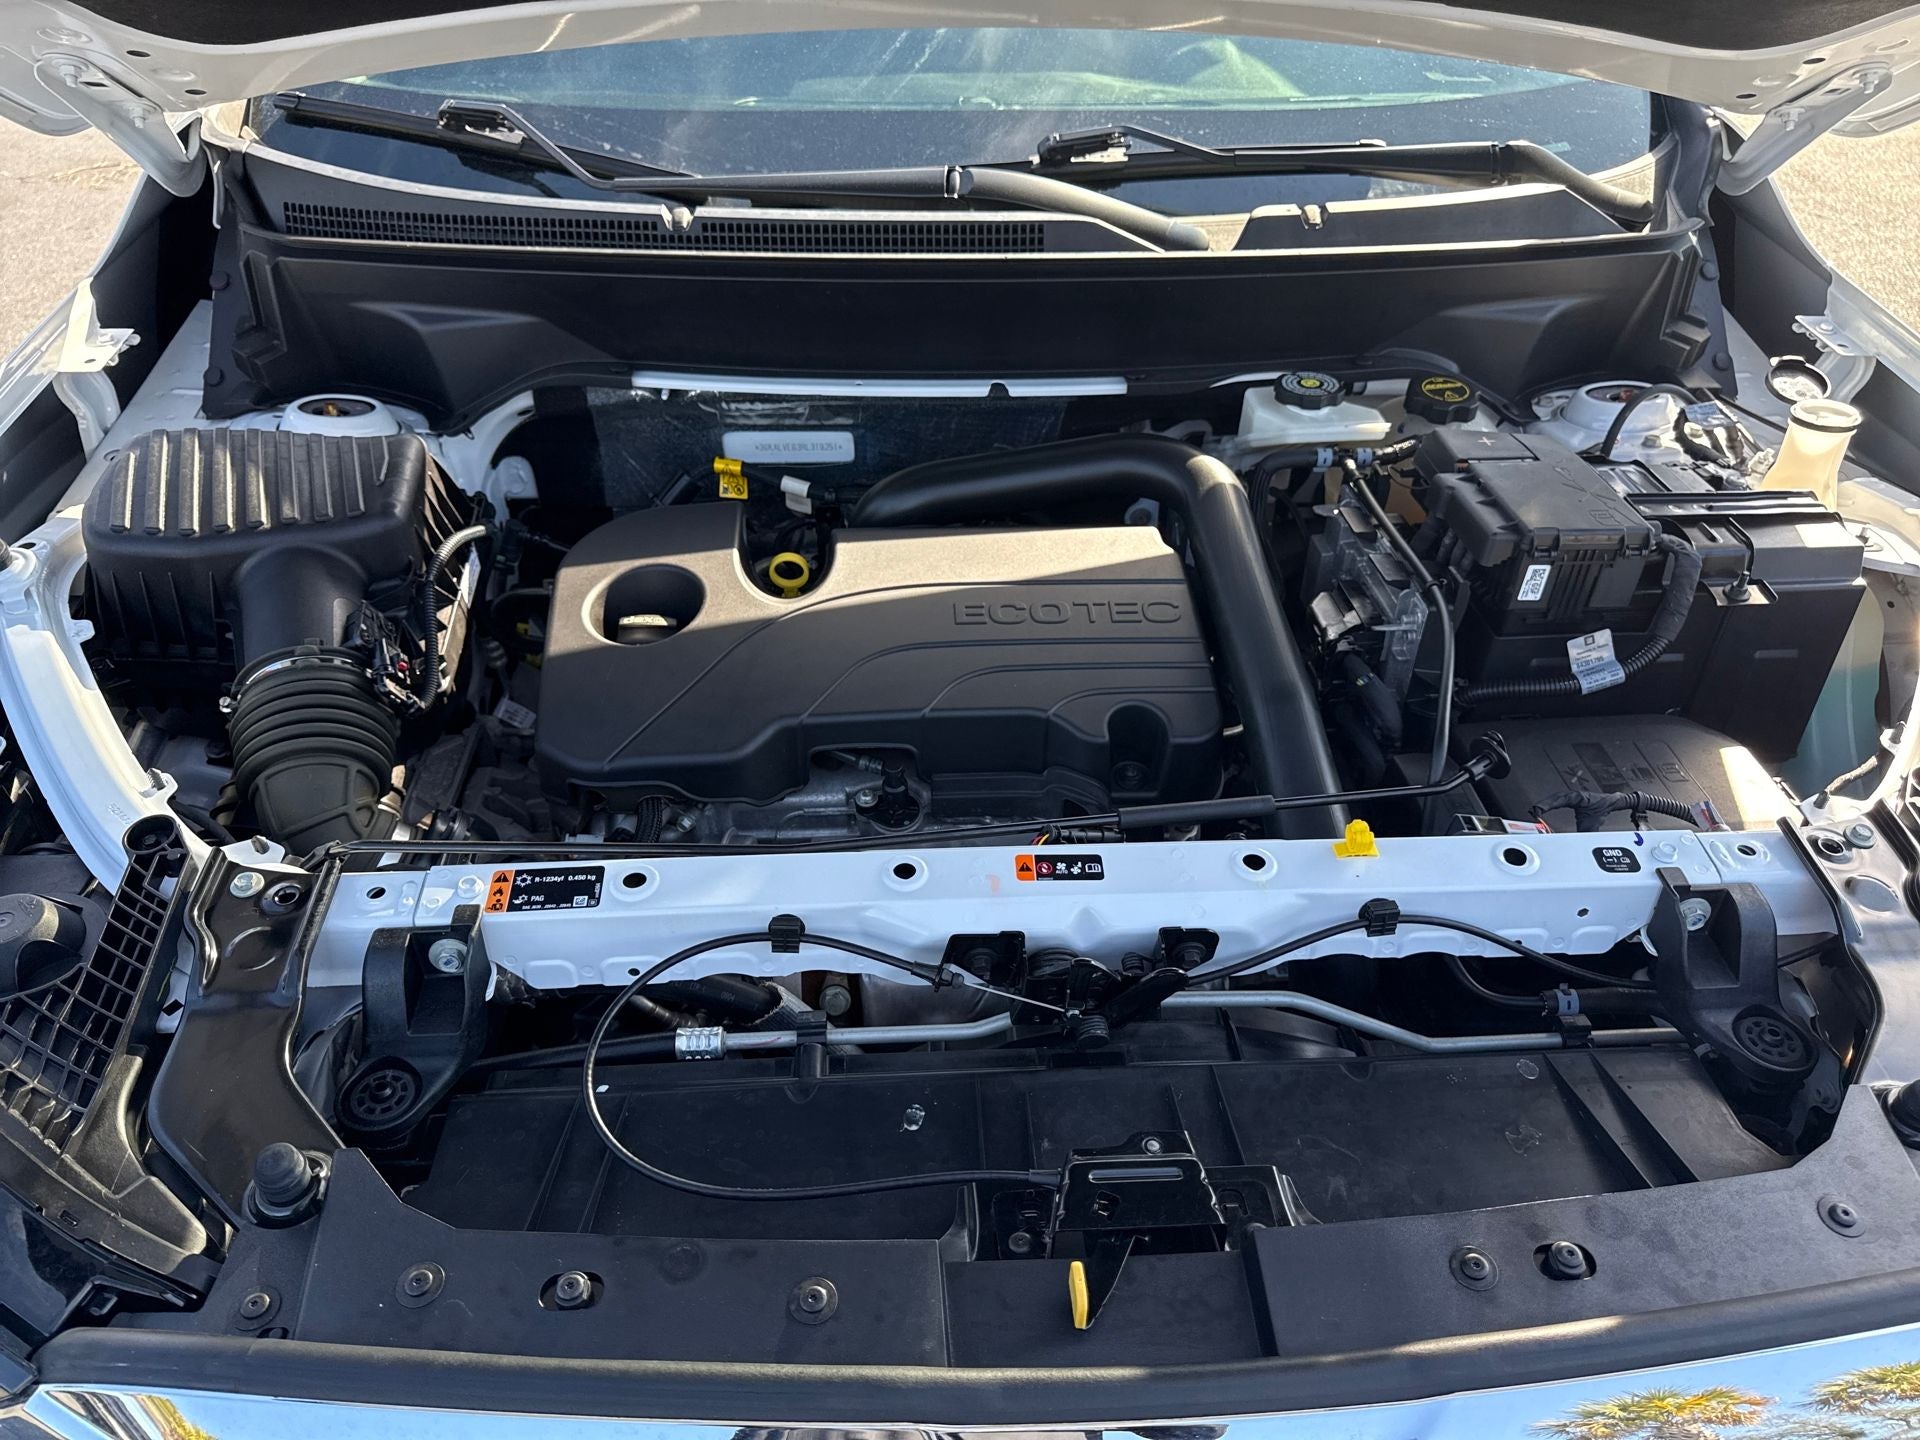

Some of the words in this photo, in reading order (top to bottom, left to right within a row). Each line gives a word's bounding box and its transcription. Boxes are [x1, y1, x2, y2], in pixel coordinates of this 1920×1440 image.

[953, 601, 1182, 625] ECOTEC
[1602, 849, 1623, 857] GND
[534, 875, 565, 883] R-1234yf
